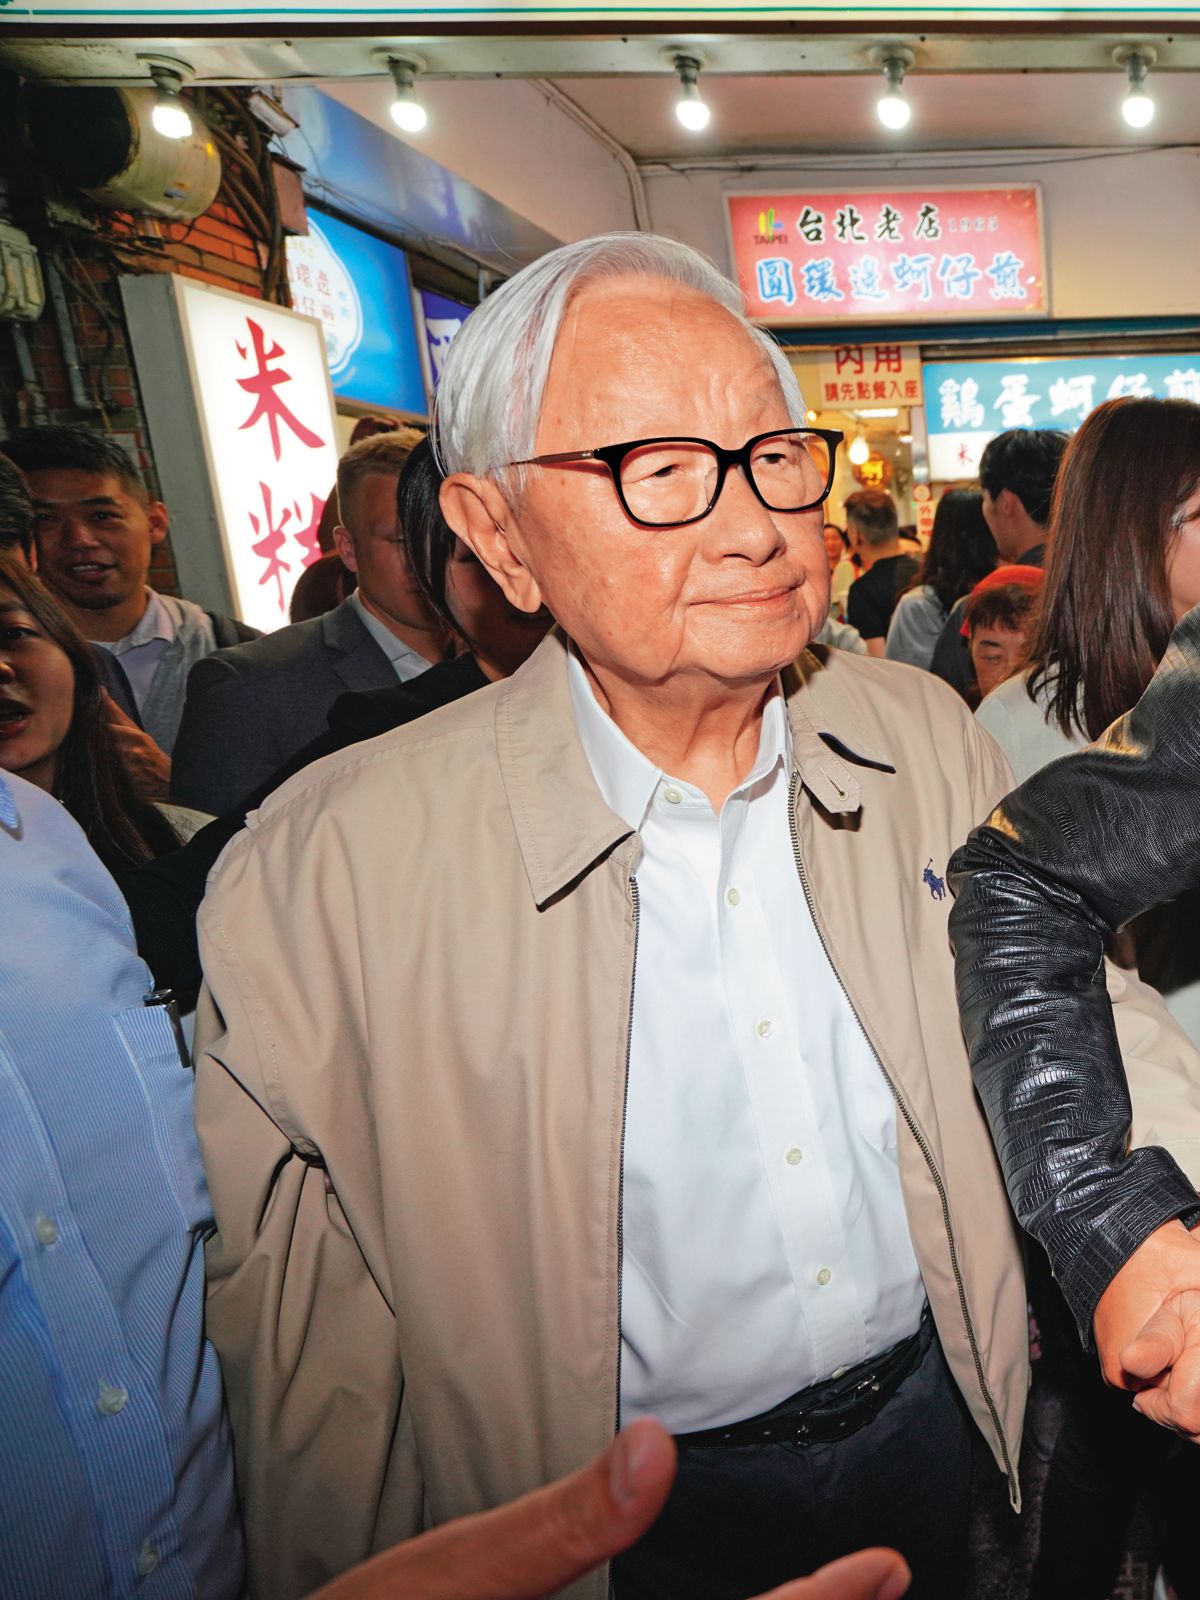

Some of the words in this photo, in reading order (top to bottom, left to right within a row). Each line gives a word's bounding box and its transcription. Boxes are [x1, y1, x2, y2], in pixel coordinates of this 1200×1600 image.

[798, 206, 940, 243] 台北老店
[754, 233, 788, 246] TAIPEI
[757, 251, 1026, 304] 圓環邊蚵仔煎
[825, 380, 919, 402] 請先點餐入座
